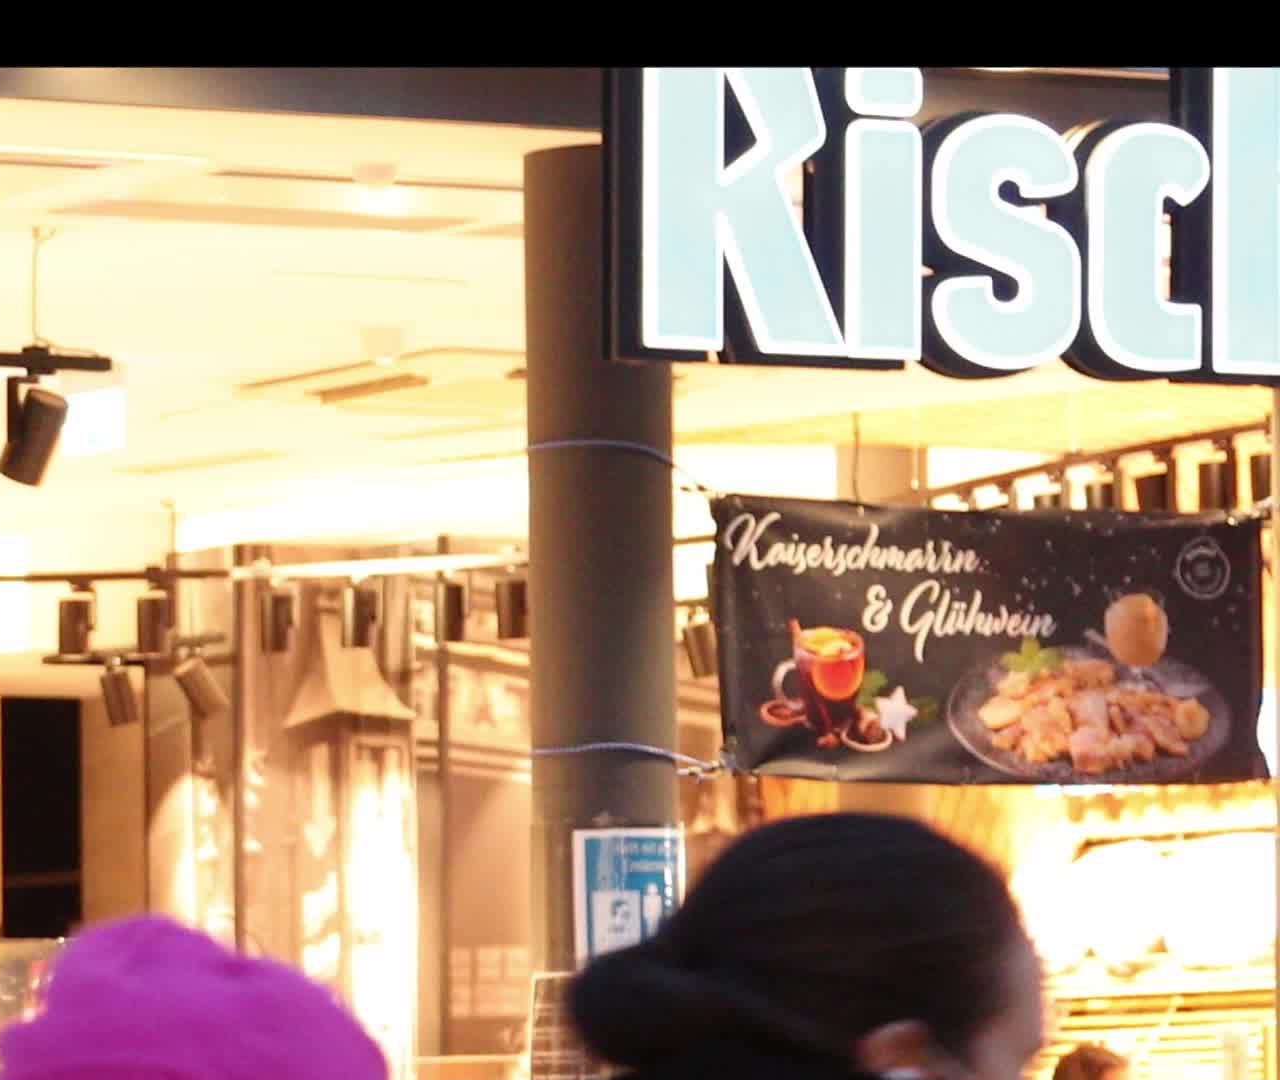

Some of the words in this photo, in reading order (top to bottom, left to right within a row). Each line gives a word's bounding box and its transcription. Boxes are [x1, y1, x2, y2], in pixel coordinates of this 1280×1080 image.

[643, 68, 1280, 374] Risc
[724, 511, 981, 578] Kaiserschmarrn
[861, 585, 893, 633] &
[898, 579, 1058, 662] Glühwein
